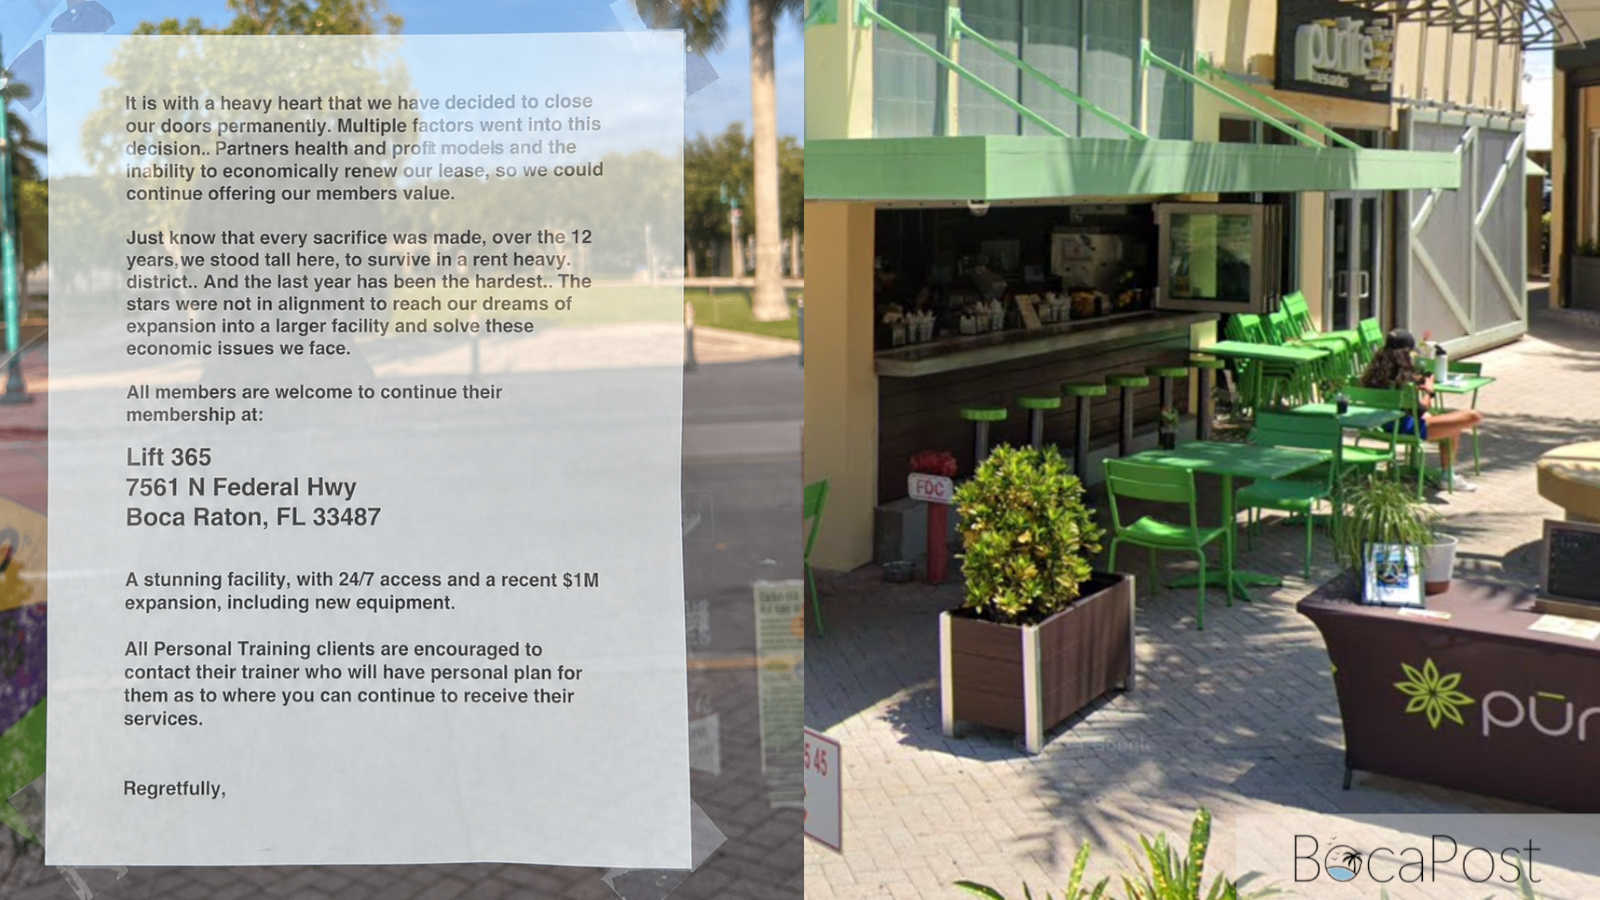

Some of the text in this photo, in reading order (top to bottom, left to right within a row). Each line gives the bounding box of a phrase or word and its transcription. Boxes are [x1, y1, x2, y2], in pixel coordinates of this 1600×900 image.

[126, 94, 592, 113] It is with a heavy heart that we have decided to close
[126, 116, 601, 137] our doors permanently. Multiple factors went into this
[127, 139, 576, 159] decision.. Partners health and profit models and the
[127, 185, 454, 204] continue offering our members value.
[126, 229, 592, 248] Just know that every sacrifice was made, over the 12
[210, 252, 259, 267] stood
[265, 252, 290, 266] tall
[297, 252, 339, 269] here,
[345, 253, 362, 266] to
[368, 252, 431, 266] survive
[437, 252, 453, 266] in
[457, 256, 467, 266] a
[473, 253, 508, 266] rent
[127, 274, 591, 292] district.. And the last year has been the hardest.. The
[127, 296, 572, 314] stars were not in alignment to reach our dreams of
[127, 318, 534, 336] expansion into a larger facility and solve these
[127, 384, 502, 399] All members are welcome to continue their
[127, 407, 263, 425] membership at:
[128, 447, 211, 466] Lift 365
[126, 477, 356, 501] 7561 N Federal Hwy
[916, 479, 945, 497] FDC
[127, 507, 381, 529] Boca Raton, FL 33487
[126, 571, 598, 590] A stunning facility, with 24/7 access and a recent $1M
[125, 594, 455, 613] expansion, including new equipment.
[125, 641, 542, 660] All Personal Training clients are encouraged to
[125, 664, 582, 683] contact their trainer who will have personal plan for
[124, 688, 574, 706] them as to where you can continue to receive their
[124, 711, 202, 726] services.
[814, 747, 828, 777] 45
[124, 781, 225, 799] Regretfully,
